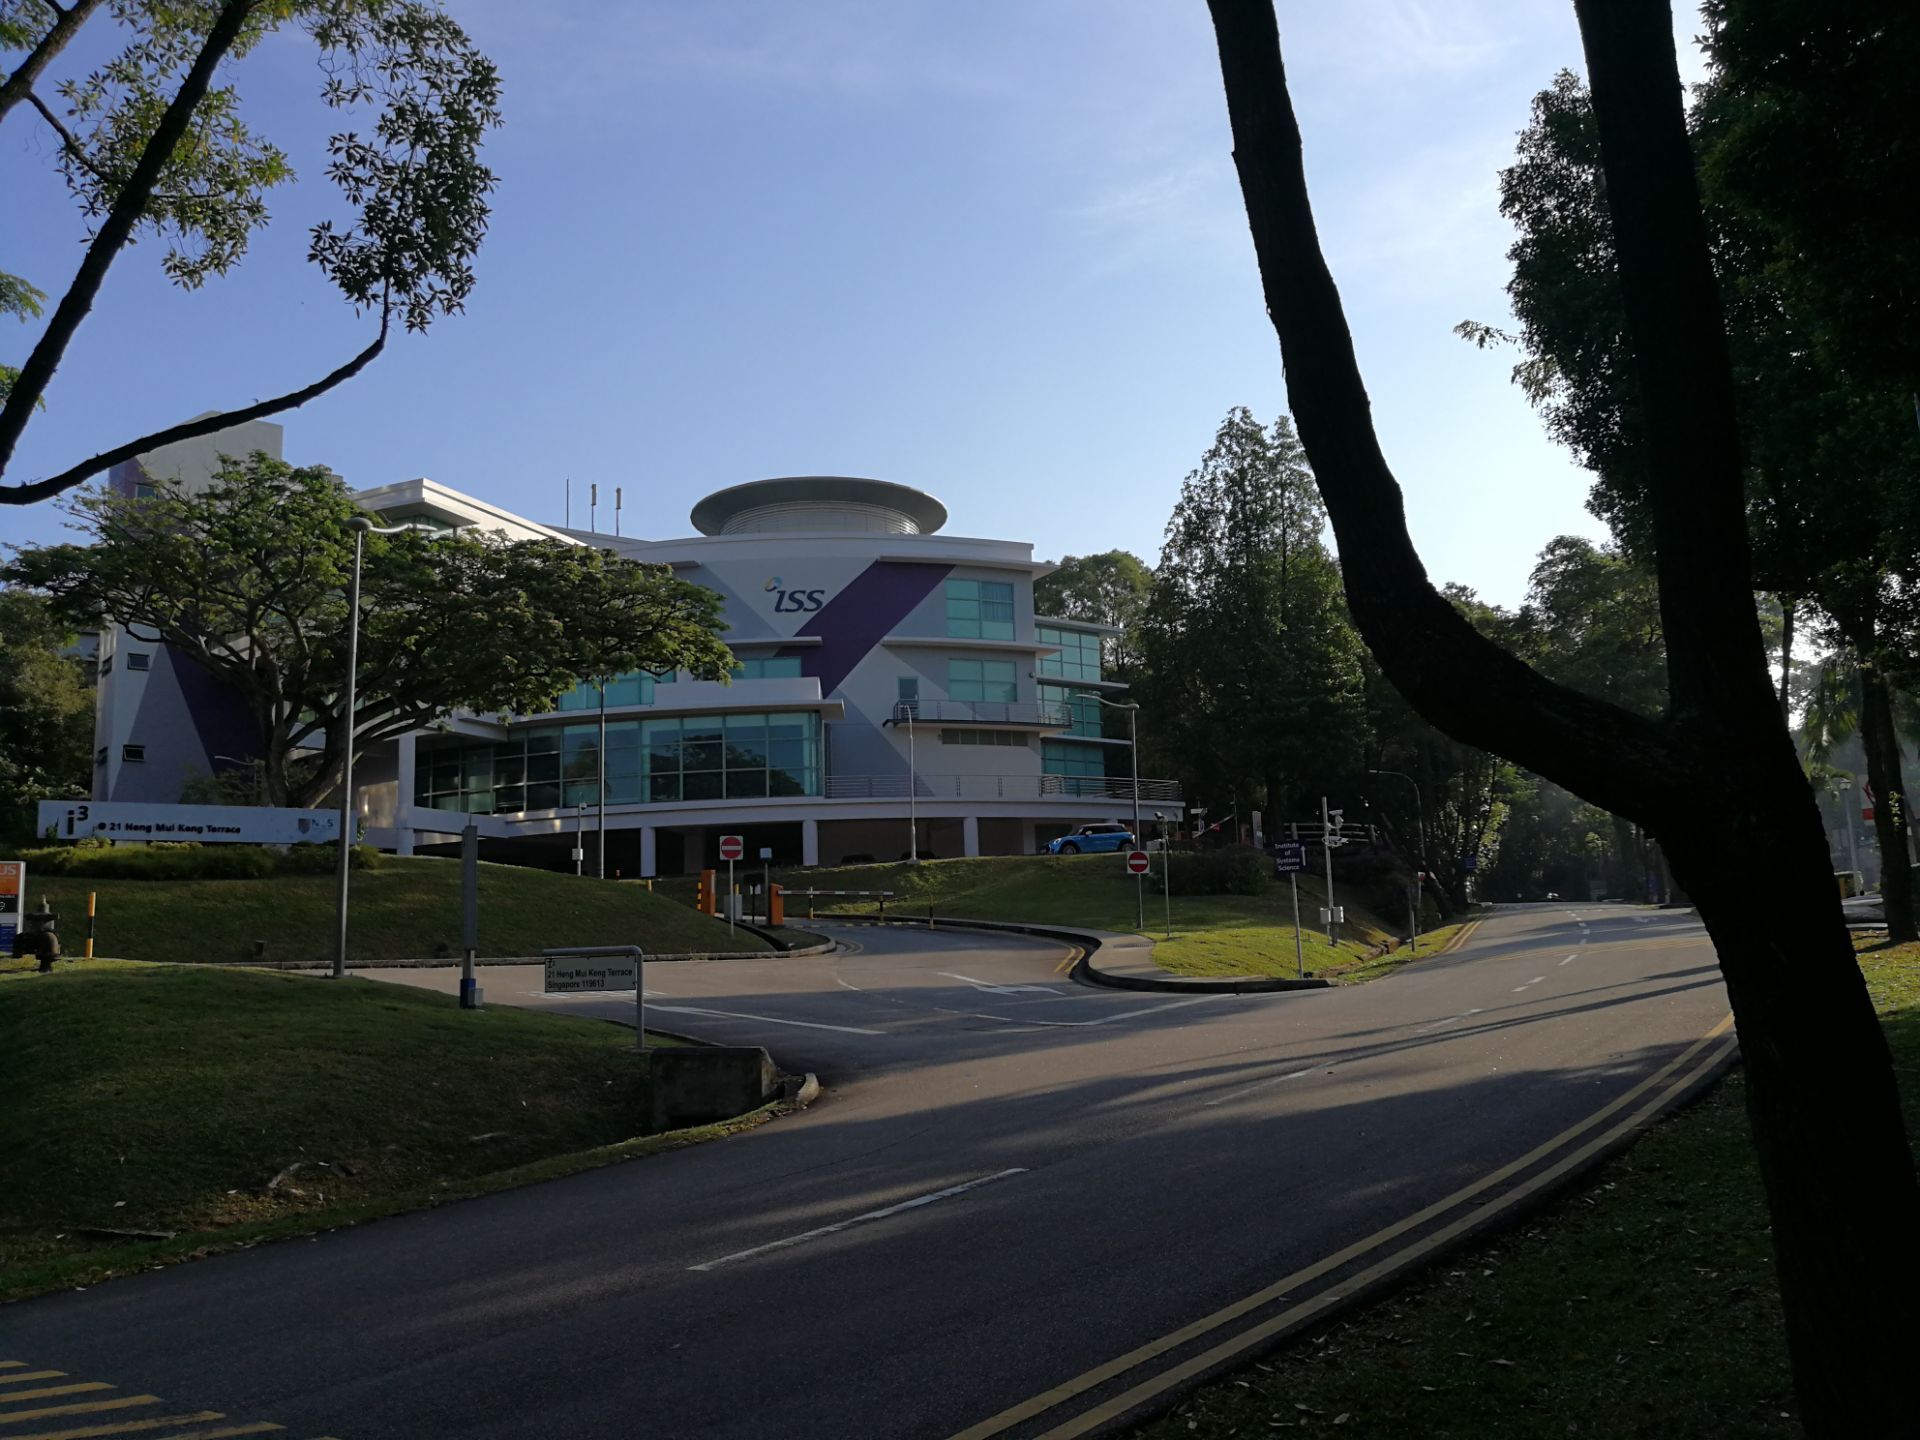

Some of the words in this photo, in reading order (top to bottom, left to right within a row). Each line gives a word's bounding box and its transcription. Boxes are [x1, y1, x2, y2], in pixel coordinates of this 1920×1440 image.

[110, 822, 121, 831] 21
[125, 823, 152, 833] Heng
[156, 823, 174, 832] Mui
[178, 824, 203, 834] Keng
[206, 824, 241, 834] Terrace
[312, 819, 333, 827] NS
[547, 970, 555, 978] 21
[557, 969, 574, 979] Heng
[575, 969, 587, 977] Mui
[588, 969, 605, 978] Keng
[607, 968, 633, 977] Terrace
[547, 980, 580, 990] Singapore
